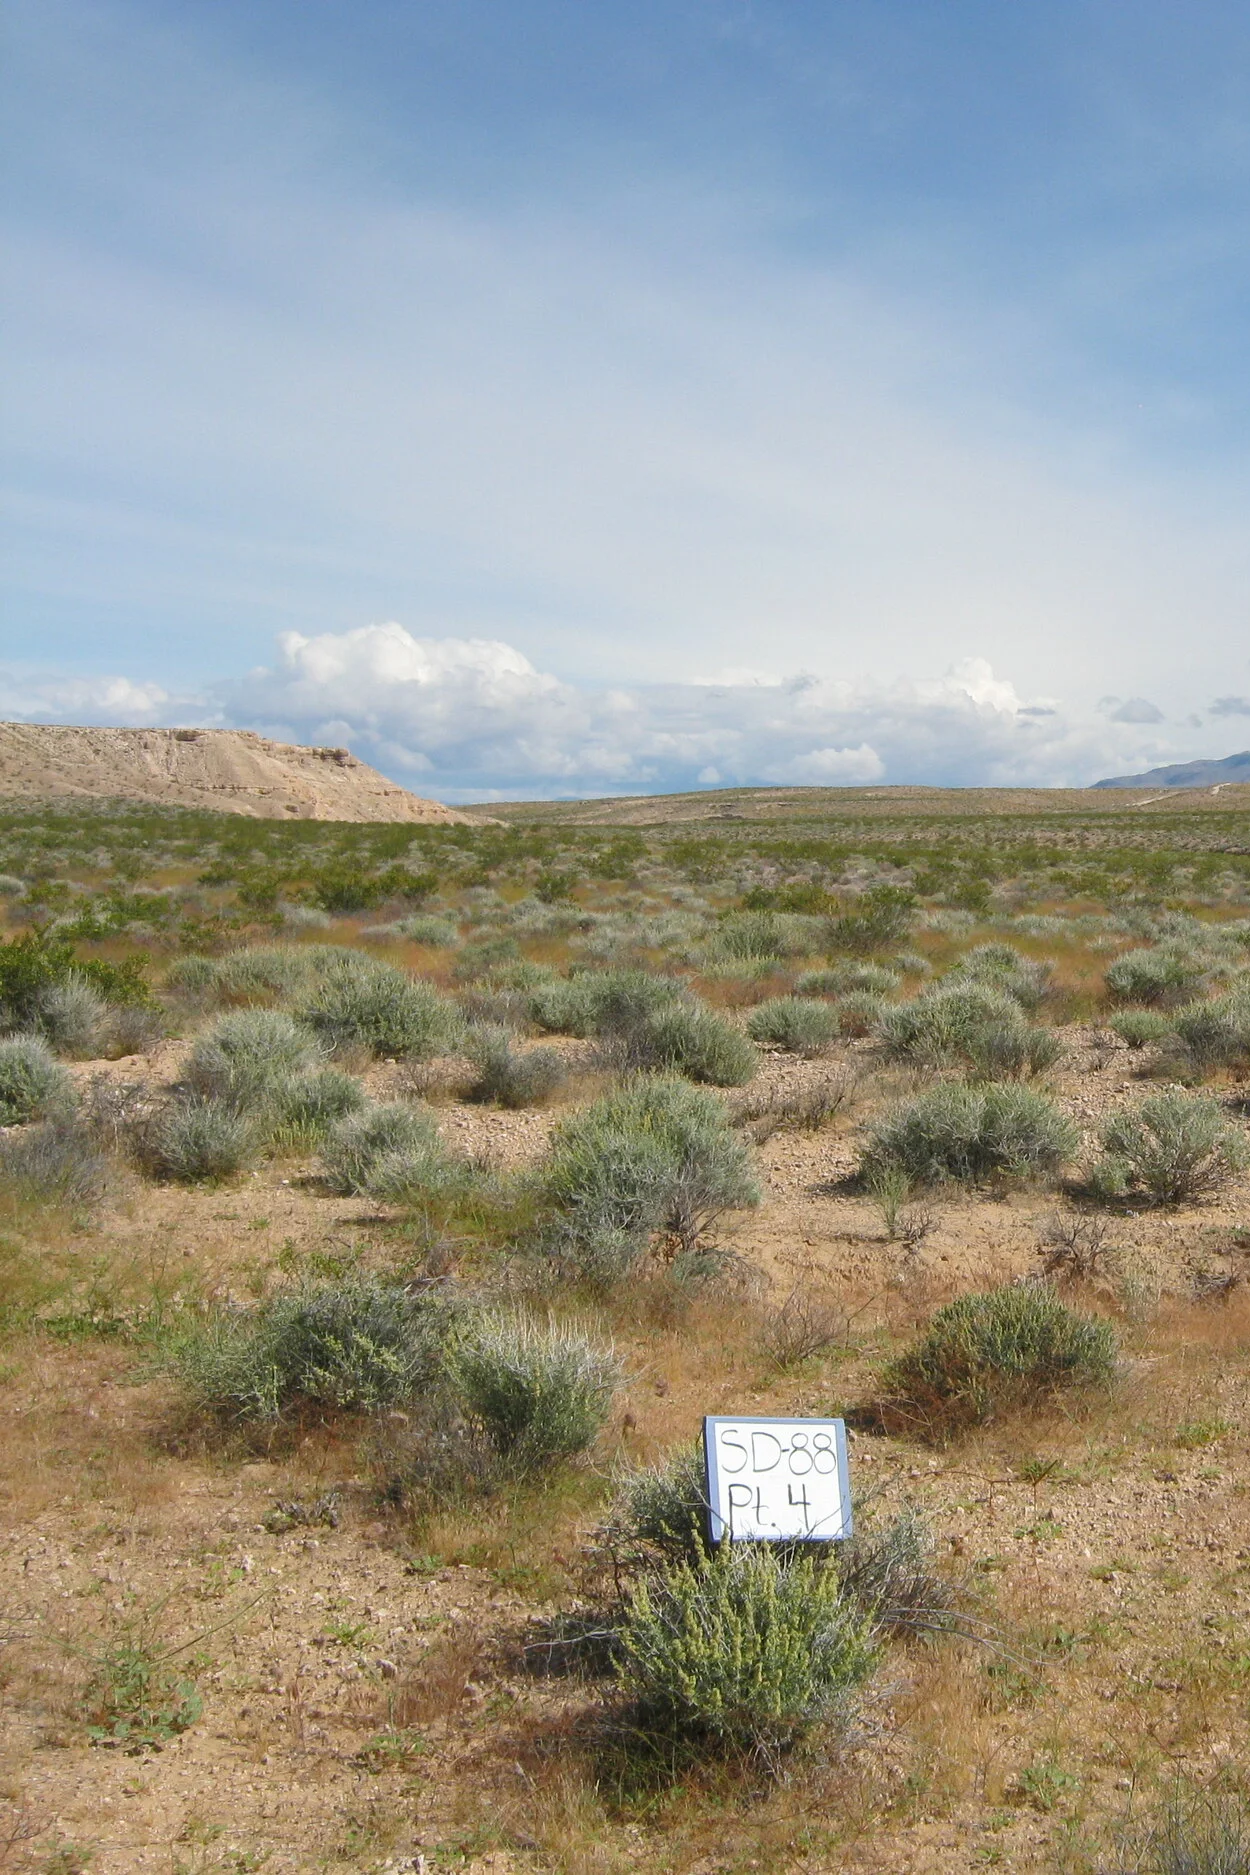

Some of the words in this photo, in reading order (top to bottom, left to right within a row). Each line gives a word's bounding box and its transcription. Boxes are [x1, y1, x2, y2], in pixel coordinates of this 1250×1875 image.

[720, 1429, 837, 1476] SD-88
[728, 1483, 776, 1532] Pt.
[787, 1483, 812, 1532] 4
